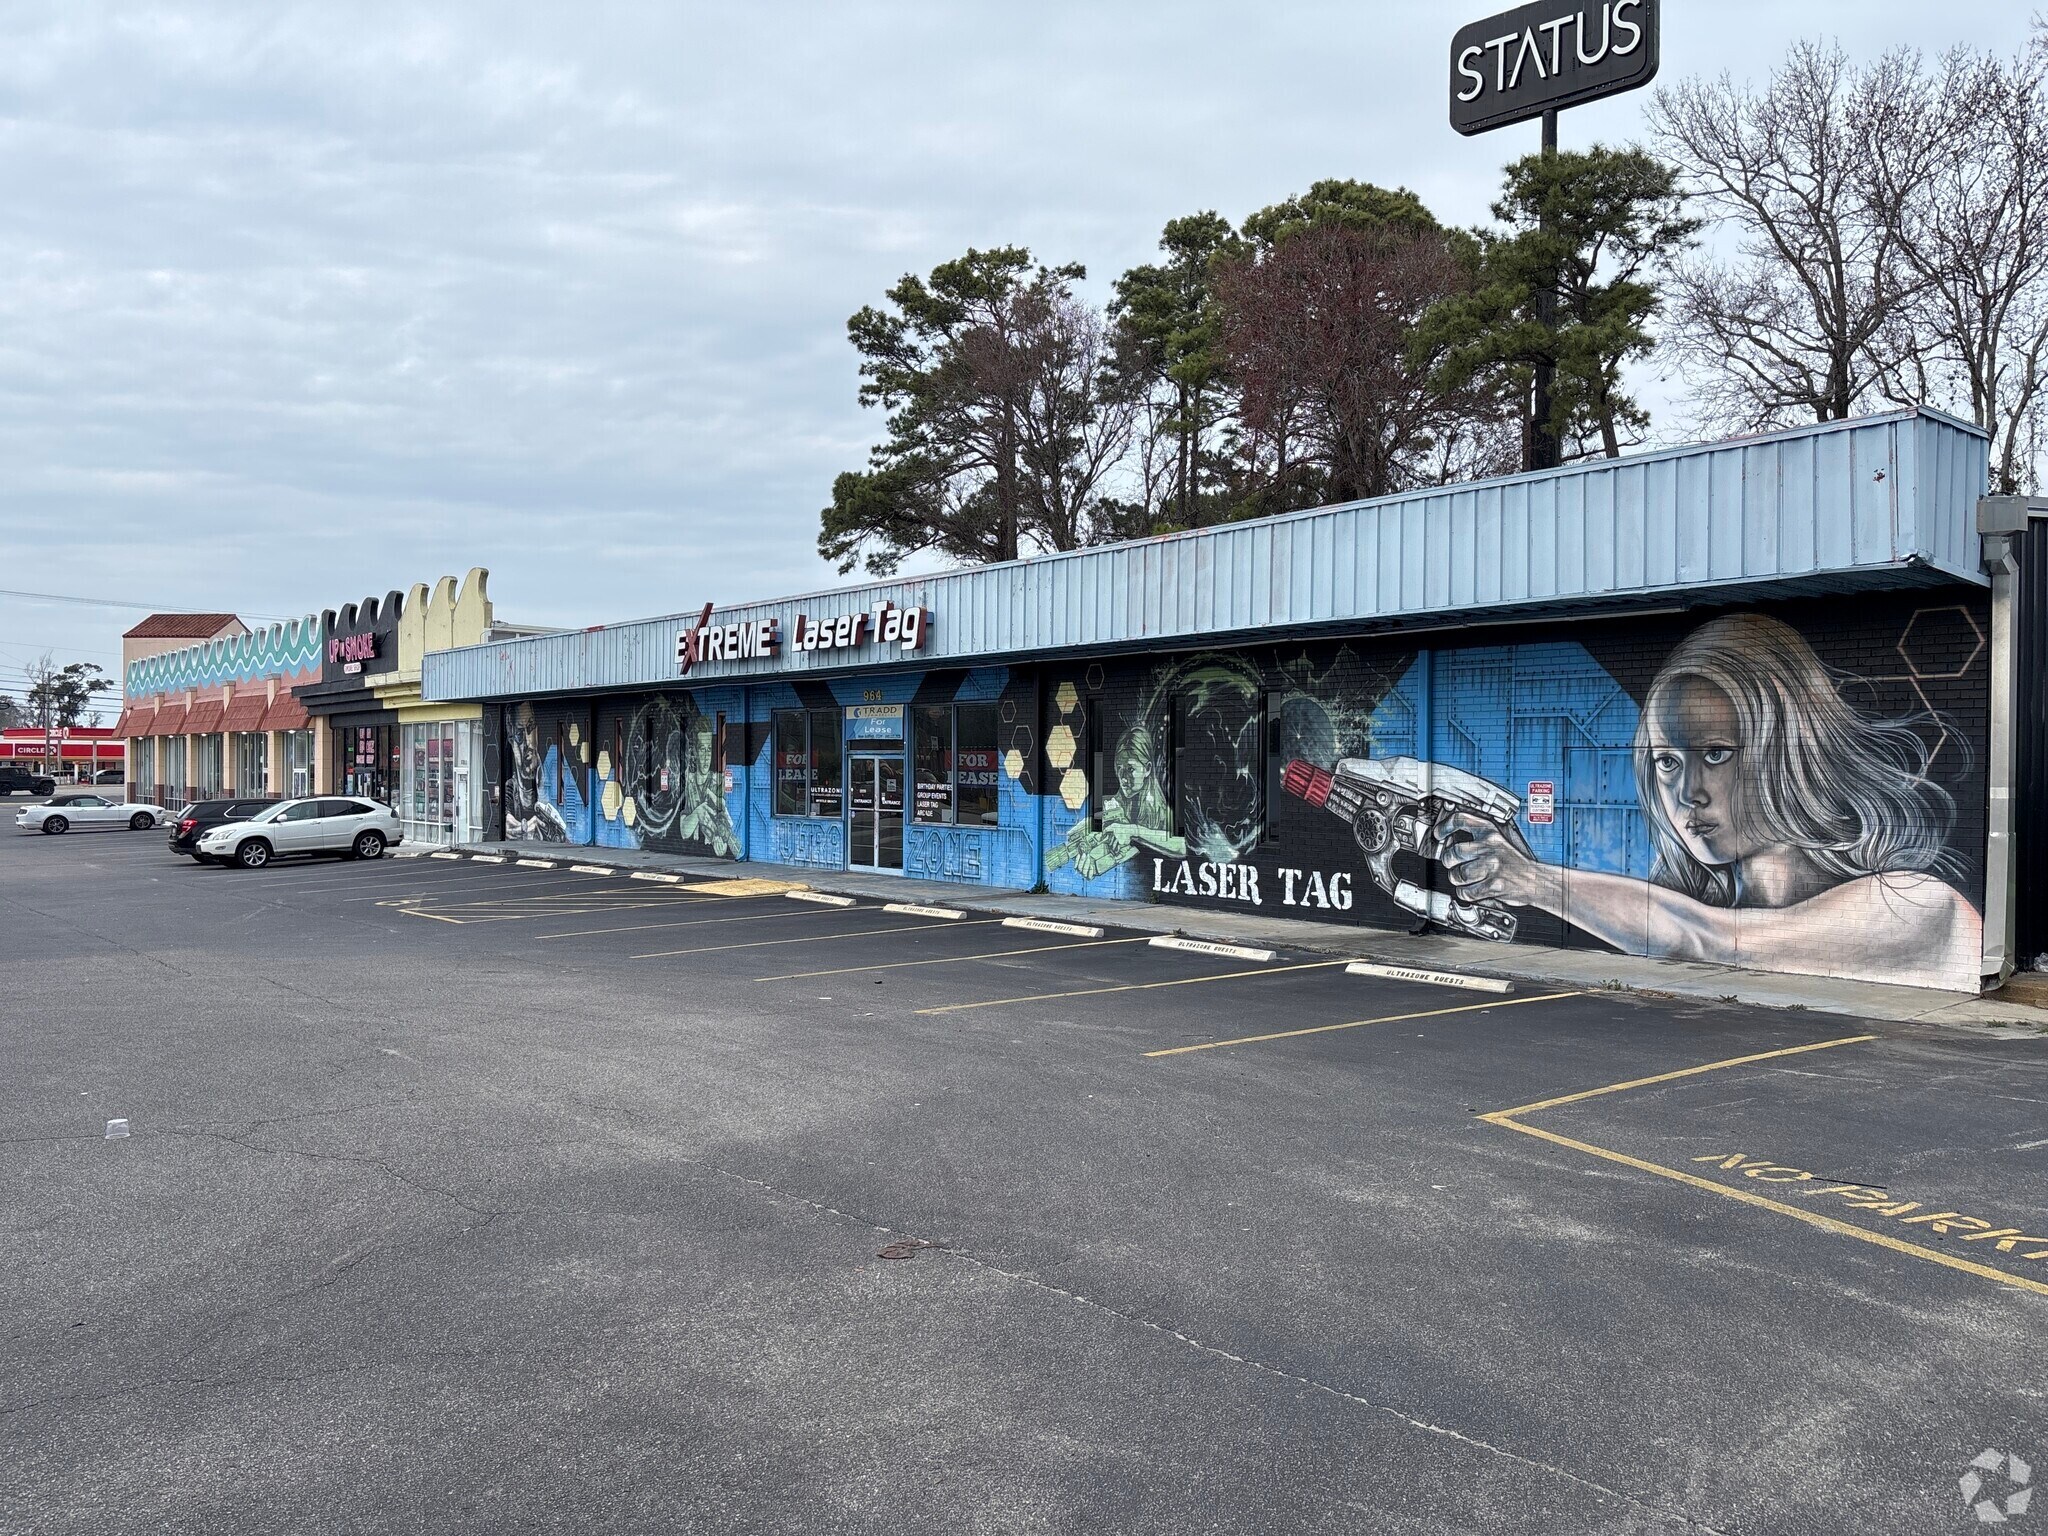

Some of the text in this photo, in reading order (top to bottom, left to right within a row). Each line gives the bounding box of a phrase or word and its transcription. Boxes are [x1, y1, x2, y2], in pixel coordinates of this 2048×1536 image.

[1457, 0, 1641, 101] STATUS
[328, 638, 340, 664] UP
[345, 632, 375, 662] SMOKE
[675, 600, 925, 675] EXTREME Laser Tag
[863, 689, 883, 702] 964
[863, 706, 897, 715] TRADD
[958, 754, 988, 767] FOR
[907, 829, 981, 879] ZONE
[1152, 857, 1353, 910] LASER TAG
[1385, 969, 1430, 981] ULTRAZONE
[1692, 1152, 1813, 1182] NO
